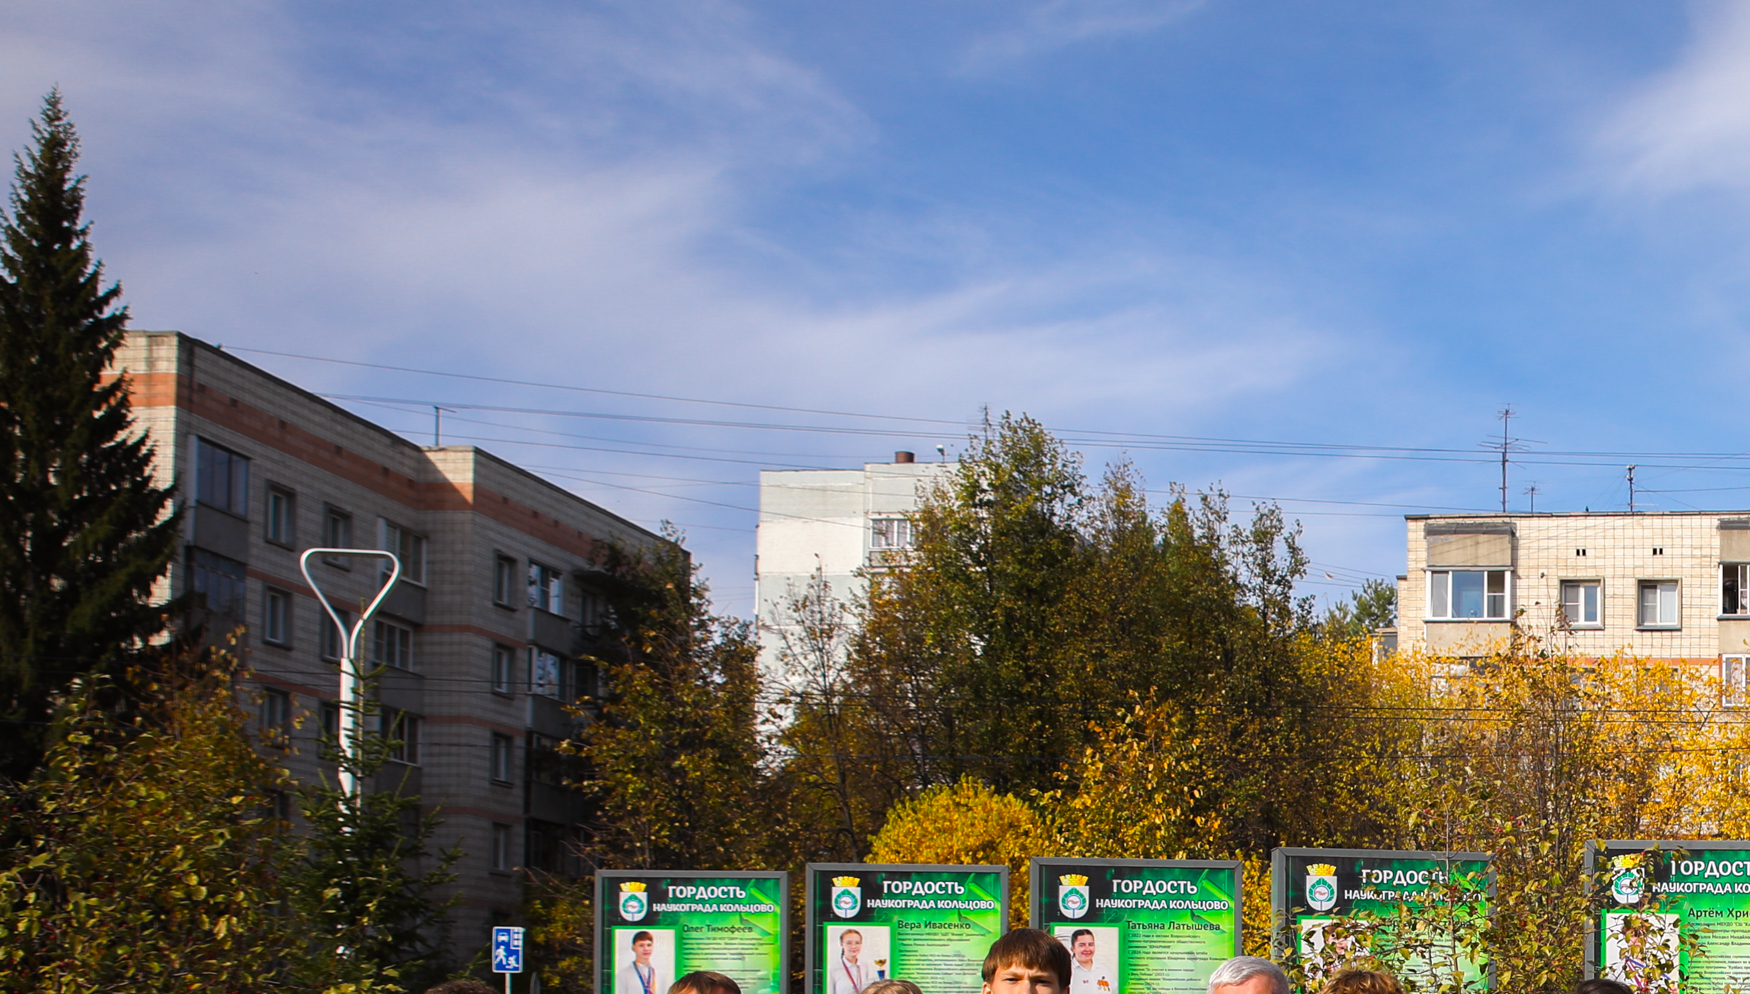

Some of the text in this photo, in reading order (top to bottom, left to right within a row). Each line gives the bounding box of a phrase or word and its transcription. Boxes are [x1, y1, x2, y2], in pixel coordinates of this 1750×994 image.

[668, 885, 746, 900] ГОРДОСТЬ
[882, 881, 965, 895] ГОРДОСТЬ
[1112, 879, 1198, 895] ГОРДОСТЬ
[1652, 882, 1732, 894] НАУКОГРАДА
[652, 903, 775, 913] НАУКОГРАДА КОЛЬЦОВО
[867, 899, 995, 910] НАУКОГРАДА КОЛЬЦОВО
[1095, 898, 1229, 911] НАУКОГРАДА КОЛЬЦОВО
[1687, 907, 1724, 920] Артём
[682, 925, 753, 934] Олег Тимофеев
[898, 920, 971, 931] Вера Ивасенко
[1125, 920, 1221, 931] Татьяна Латышева
